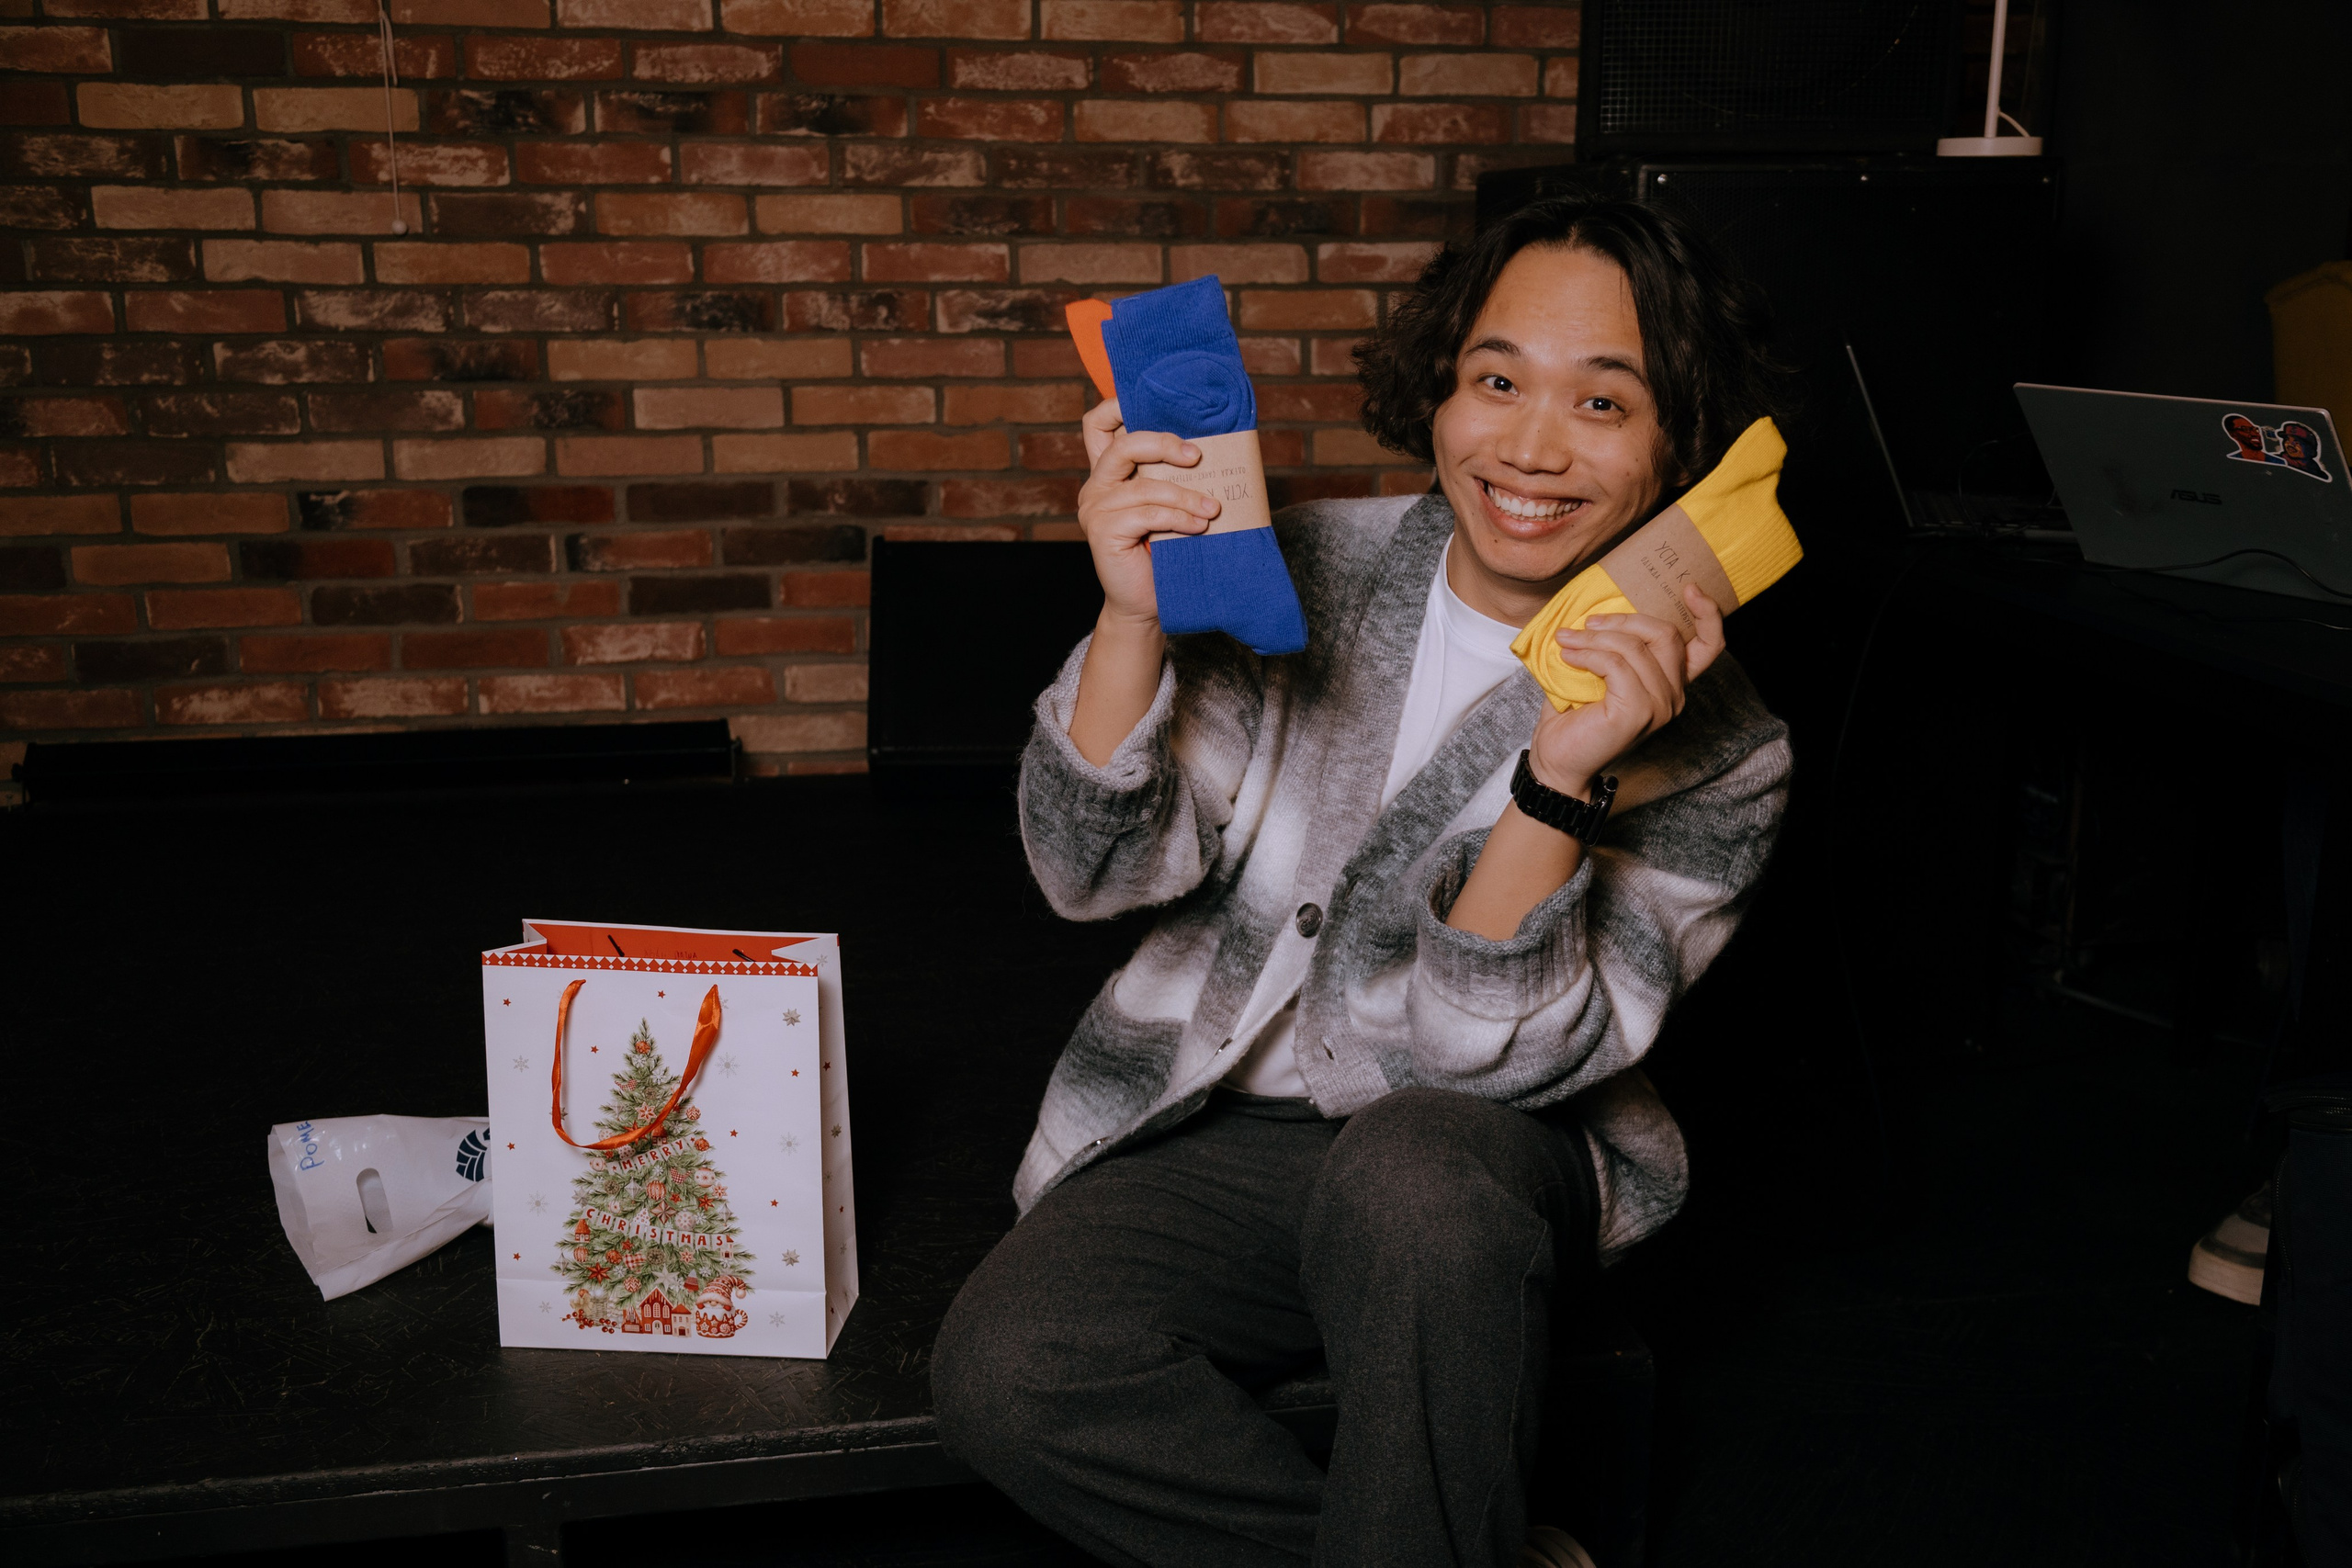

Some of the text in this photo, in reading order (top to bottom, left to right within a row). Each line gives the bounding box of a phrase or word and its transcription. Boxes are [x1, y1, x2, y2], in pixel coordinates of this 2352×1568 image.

[1220, 467, 1247, 478] ОДЕЖДА
[1224, 483, 1250, 501] УСТА
[2169, 489, 2223, 506] ASUS
[1640, 556, 1661, 580] ОДЕЖДА
[1655, 540, 1691, 583] УСТА К
[622, 1140, 684, 1169] MERRY
[585, 1207, 723, 1247] CHRISTMAS
